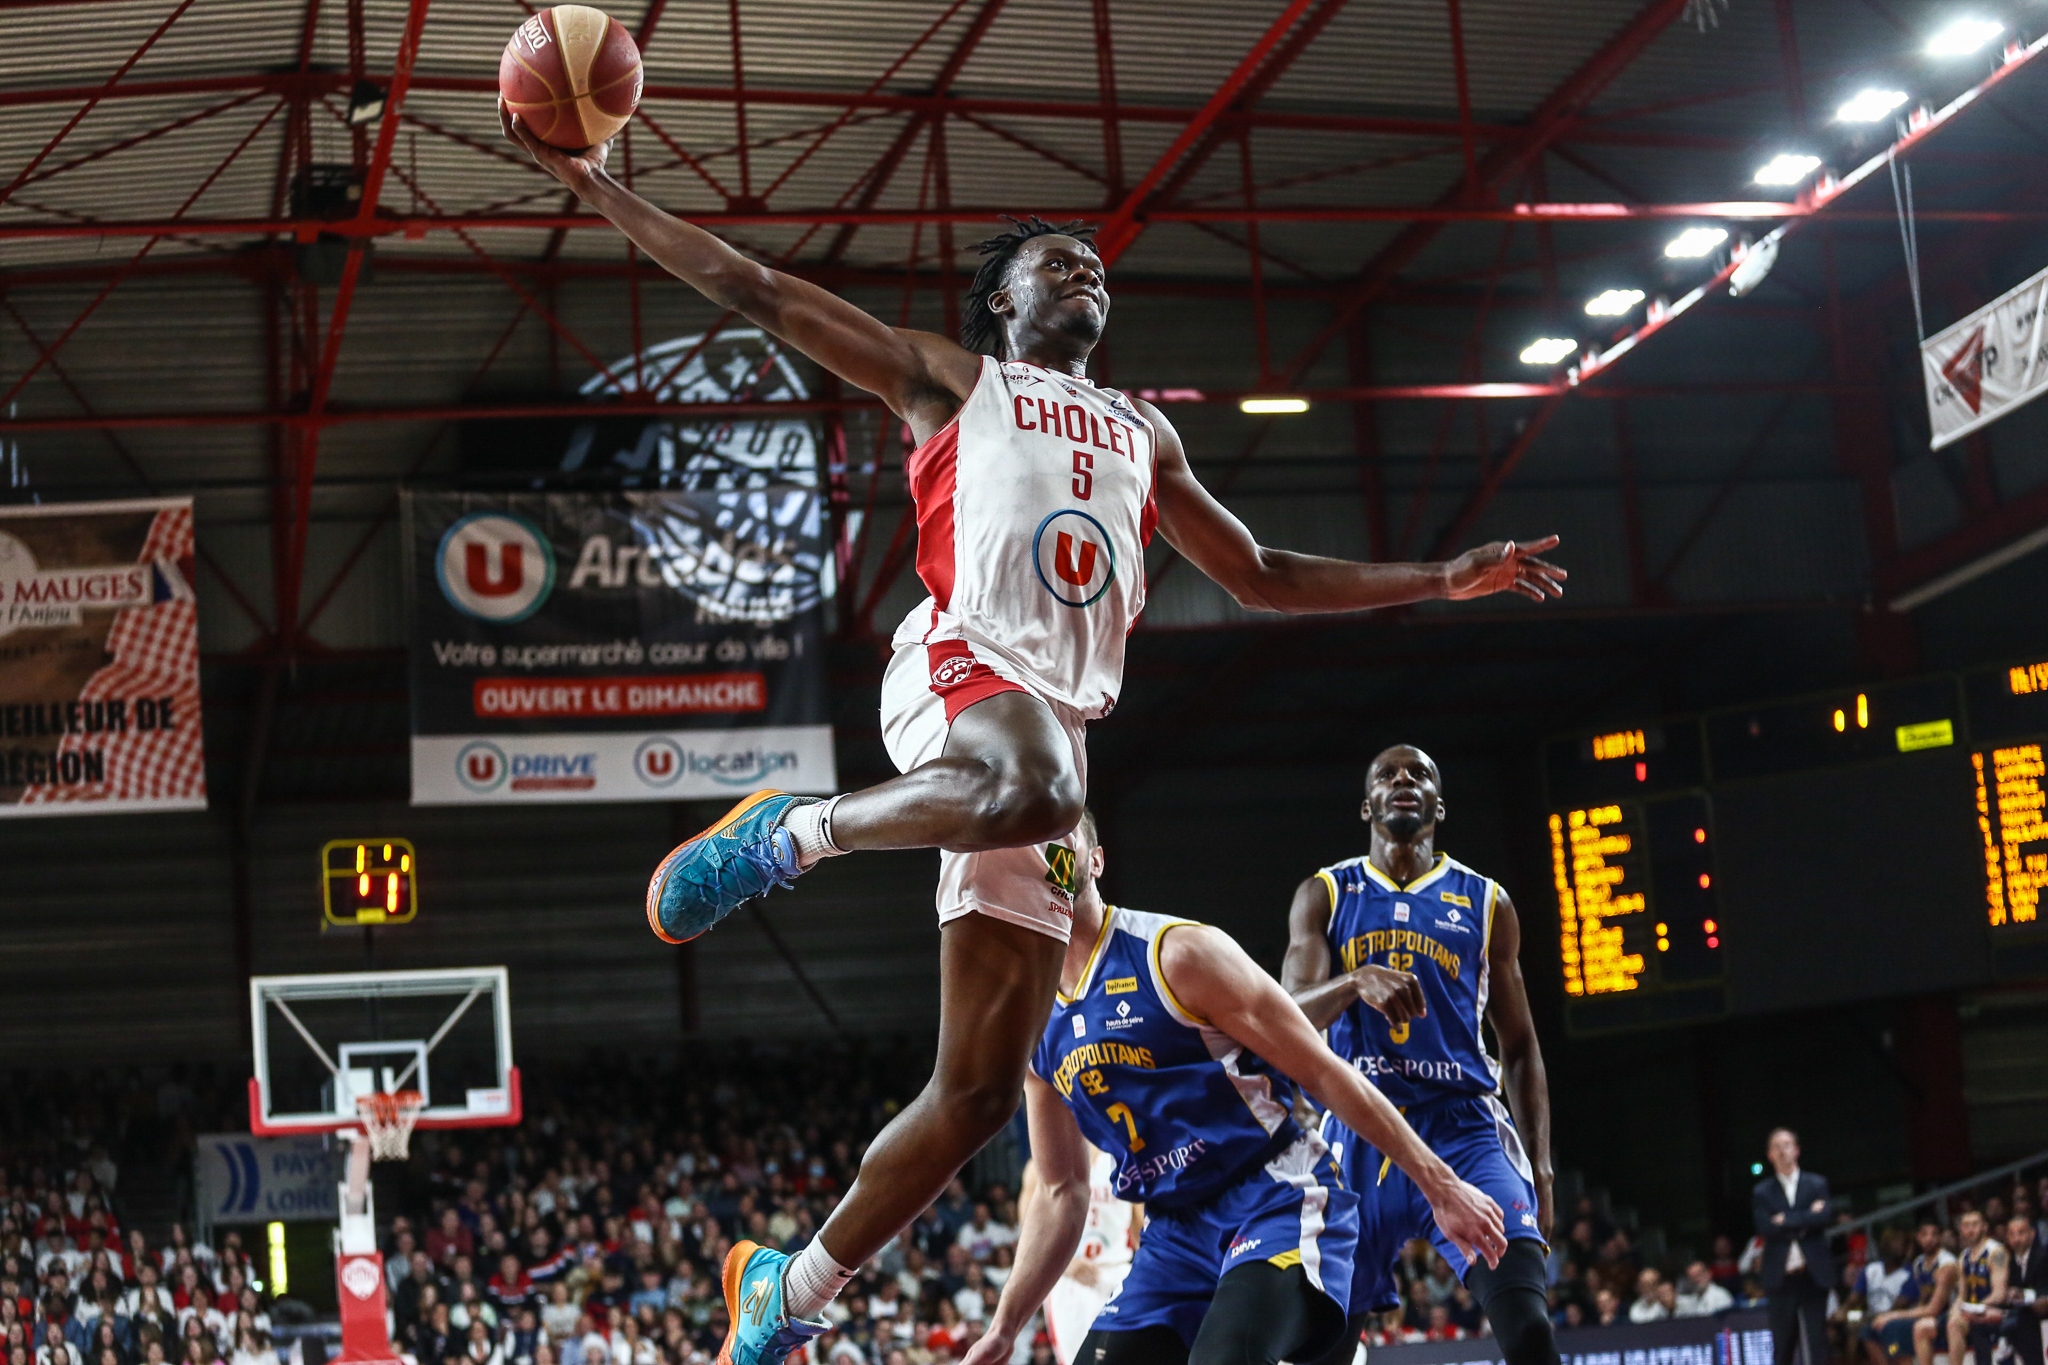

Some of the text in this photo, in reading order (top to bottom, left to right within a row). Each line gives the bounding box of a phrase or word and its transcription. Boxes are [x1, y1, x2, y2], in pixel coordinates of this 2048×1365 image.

[1014, 395, 1136, 464] CHOLET
[1072, 450, 1094, 501] 5
[465, 543, 523, 597] U
[1055, 531, 1097, 587] U
[14, 571, 143, 603] MAUGES
[432, 641, 497, 666] Votre
[480, 681, 761, 711] OUVERT LE DIMANCHE
[0, 698, 174, 736] EILLEUR DE
[468, 752, 597, 781] U DRIVE
[647, 744, 798, 776] U location
[1340, 929, 1461, 981] METROPOLITANS
[1053, 1042, 1156, 1102] MEROPOLITANS
[1079, 1069, 1110, 1096] 92
[1391, 1058, 1465, 1082] SPORT
[1106, 1102, 1146, 1153] 7
[1141, 1138, 1206, 1182] SPORT
